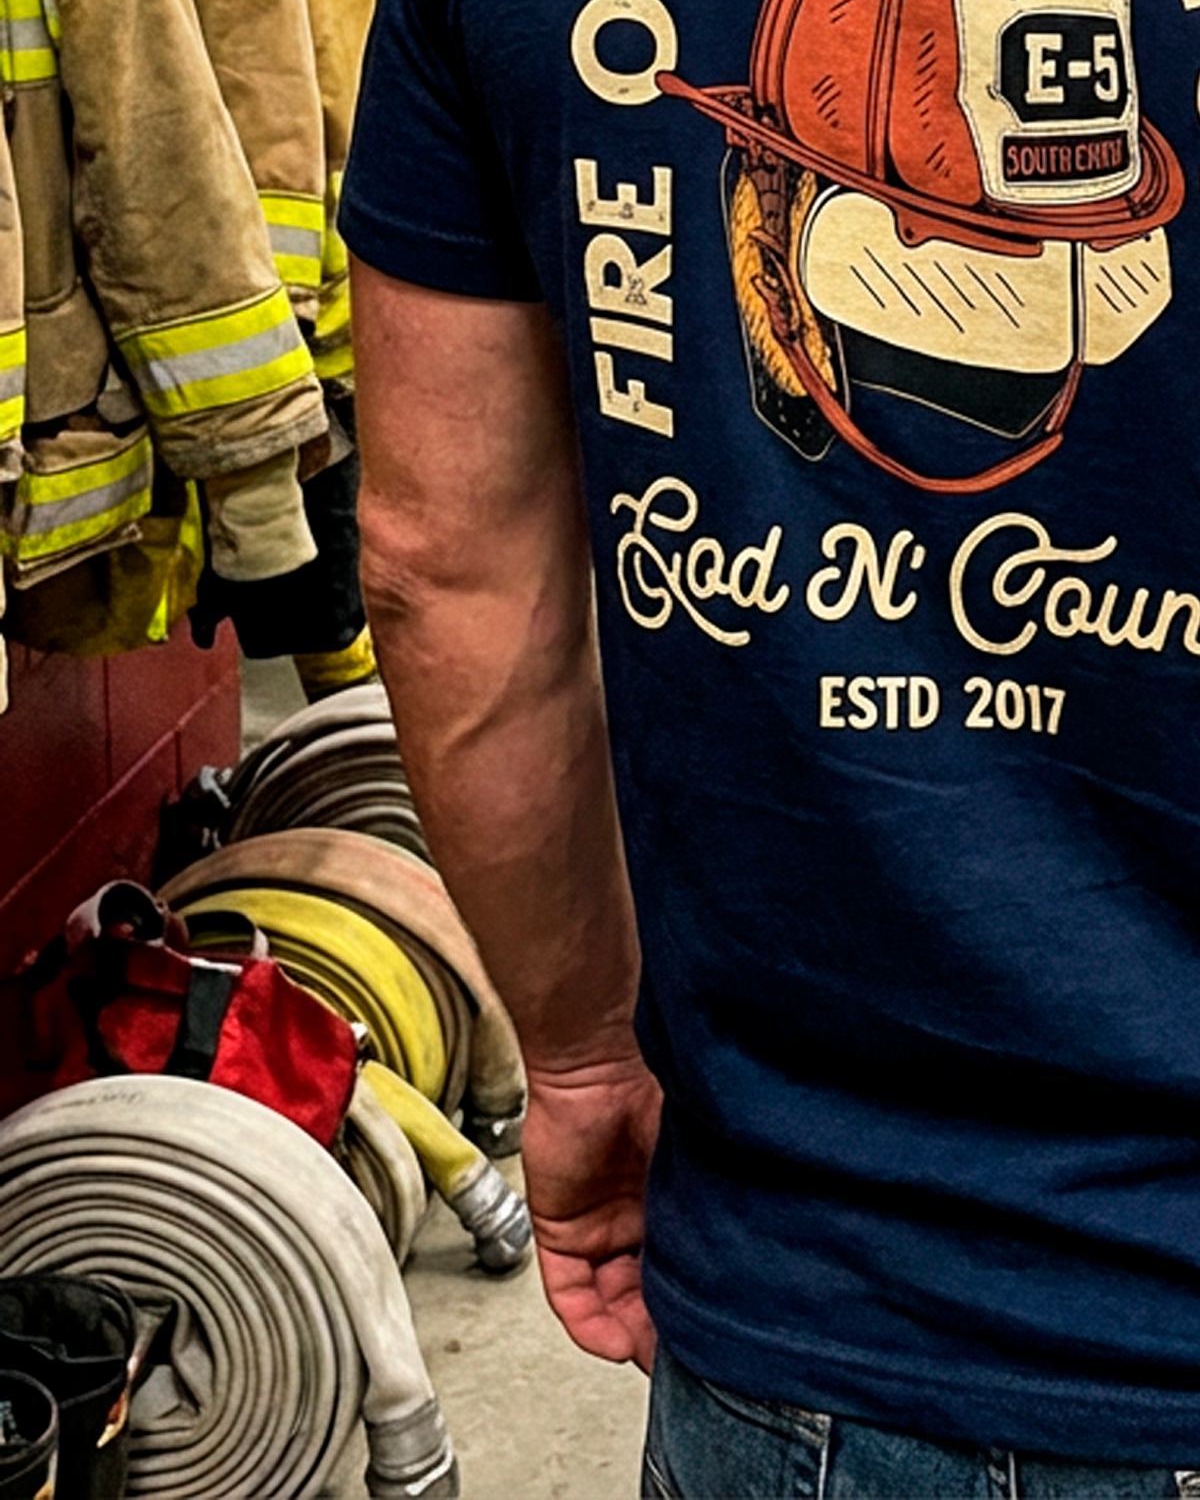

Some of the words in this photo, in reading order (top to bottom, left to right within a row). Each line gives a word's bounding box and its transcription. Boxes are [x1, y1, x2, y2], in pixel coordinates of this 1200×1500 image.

[1024, 32, 1120, 104] E-5
[574, 158, 674, 438] FIRE
[610, 476, 790, 647] God
[820, 676, 940, 730] ESTD
[964, 676, 1066, 735] 2017
